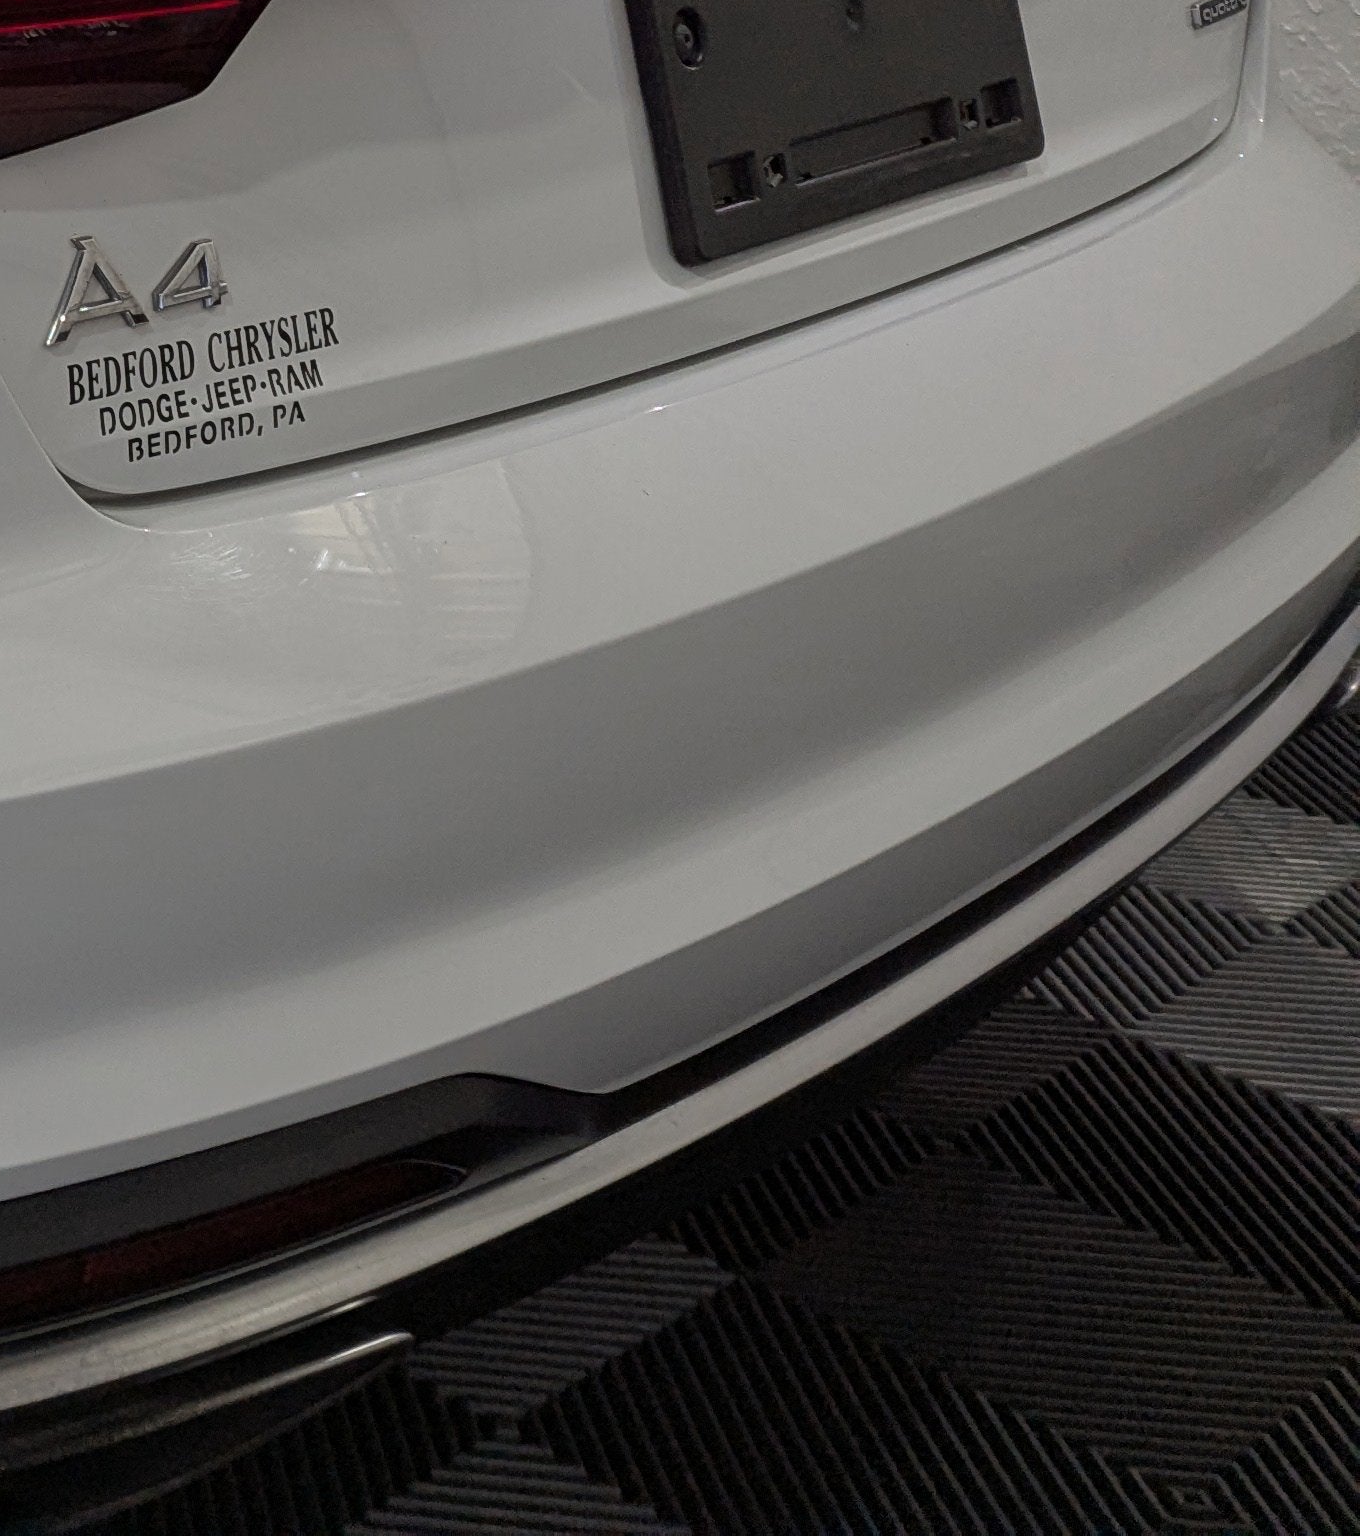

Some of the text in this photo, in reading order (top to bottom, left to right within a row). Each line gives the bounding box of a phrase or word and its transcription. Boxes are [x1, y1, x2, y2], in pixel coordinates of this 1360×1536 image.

[43, 233, 229, 347] A4
[67, 307, 340, 405] BEDFORD CHRYSLER
[128, 400, 306, 462] BEDFORD, PA
